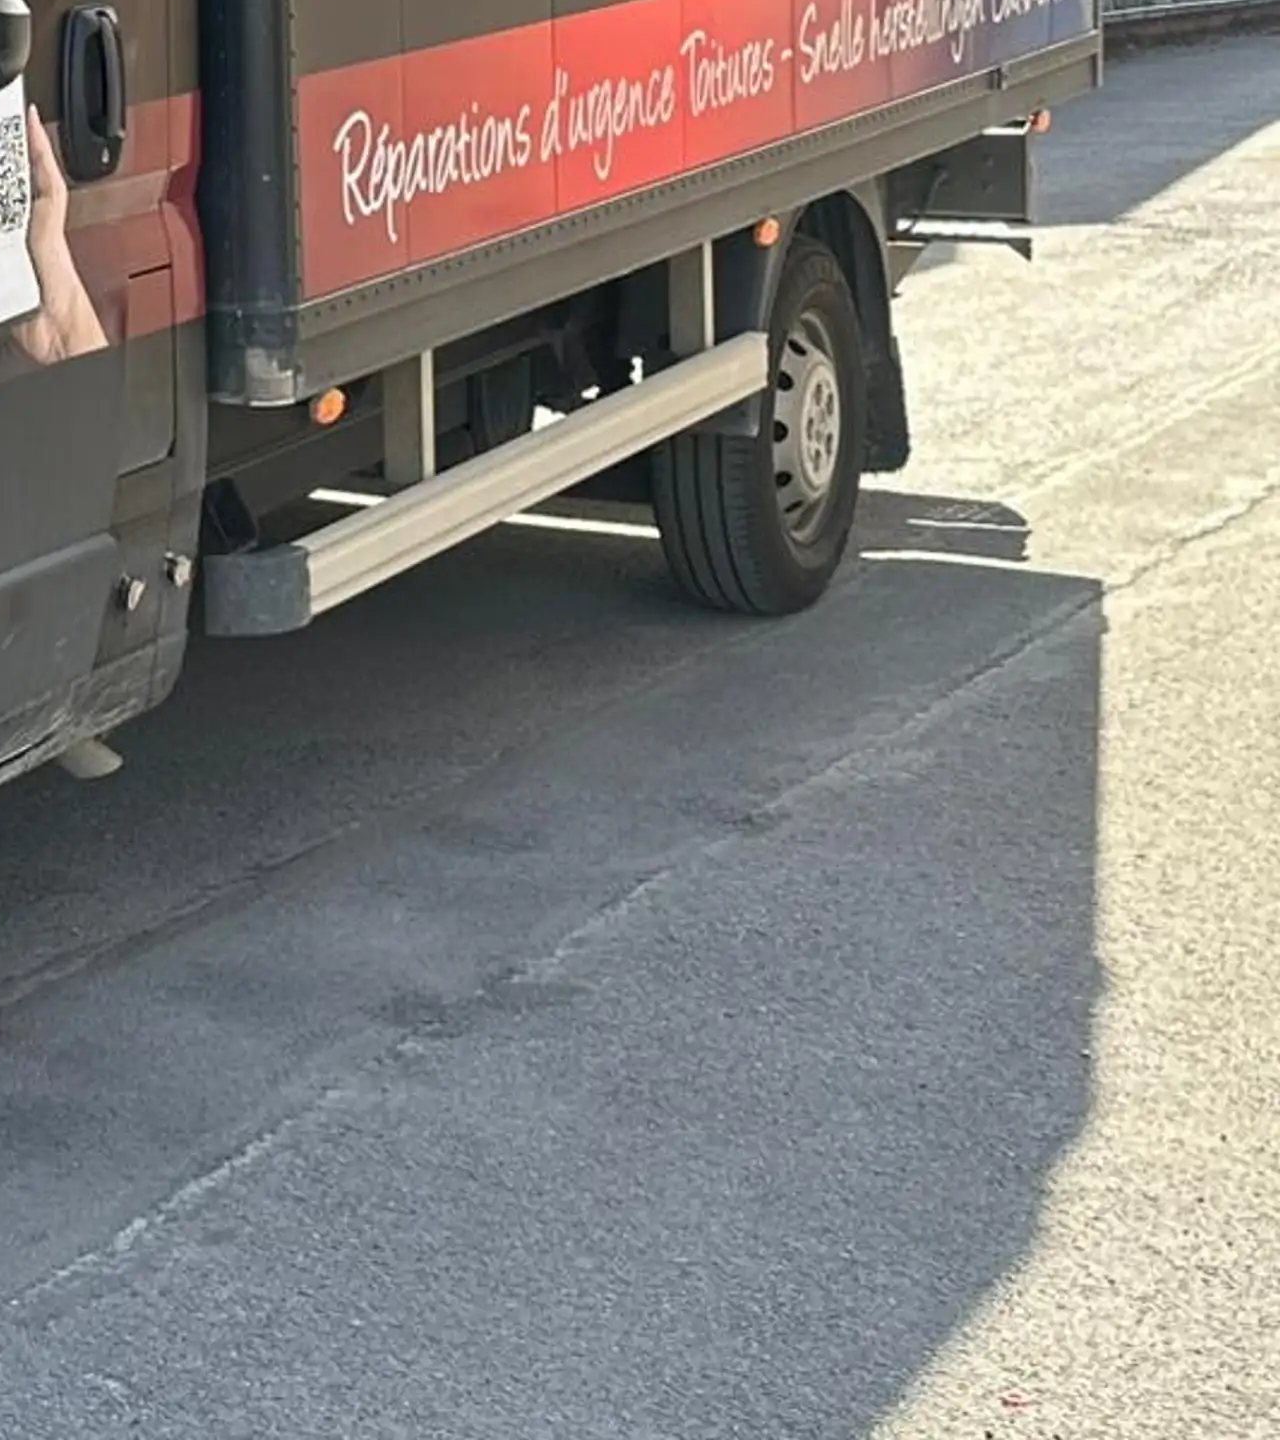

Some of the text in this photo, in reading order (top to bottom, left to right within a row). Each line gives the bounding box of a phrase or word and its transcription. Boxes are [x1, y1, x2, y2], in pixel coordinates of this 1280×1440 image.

[333, 110, 532, 243] Réparations
[540, 67, 676, 180] d'urgence
[680, 29, 775, 117] Toitures
